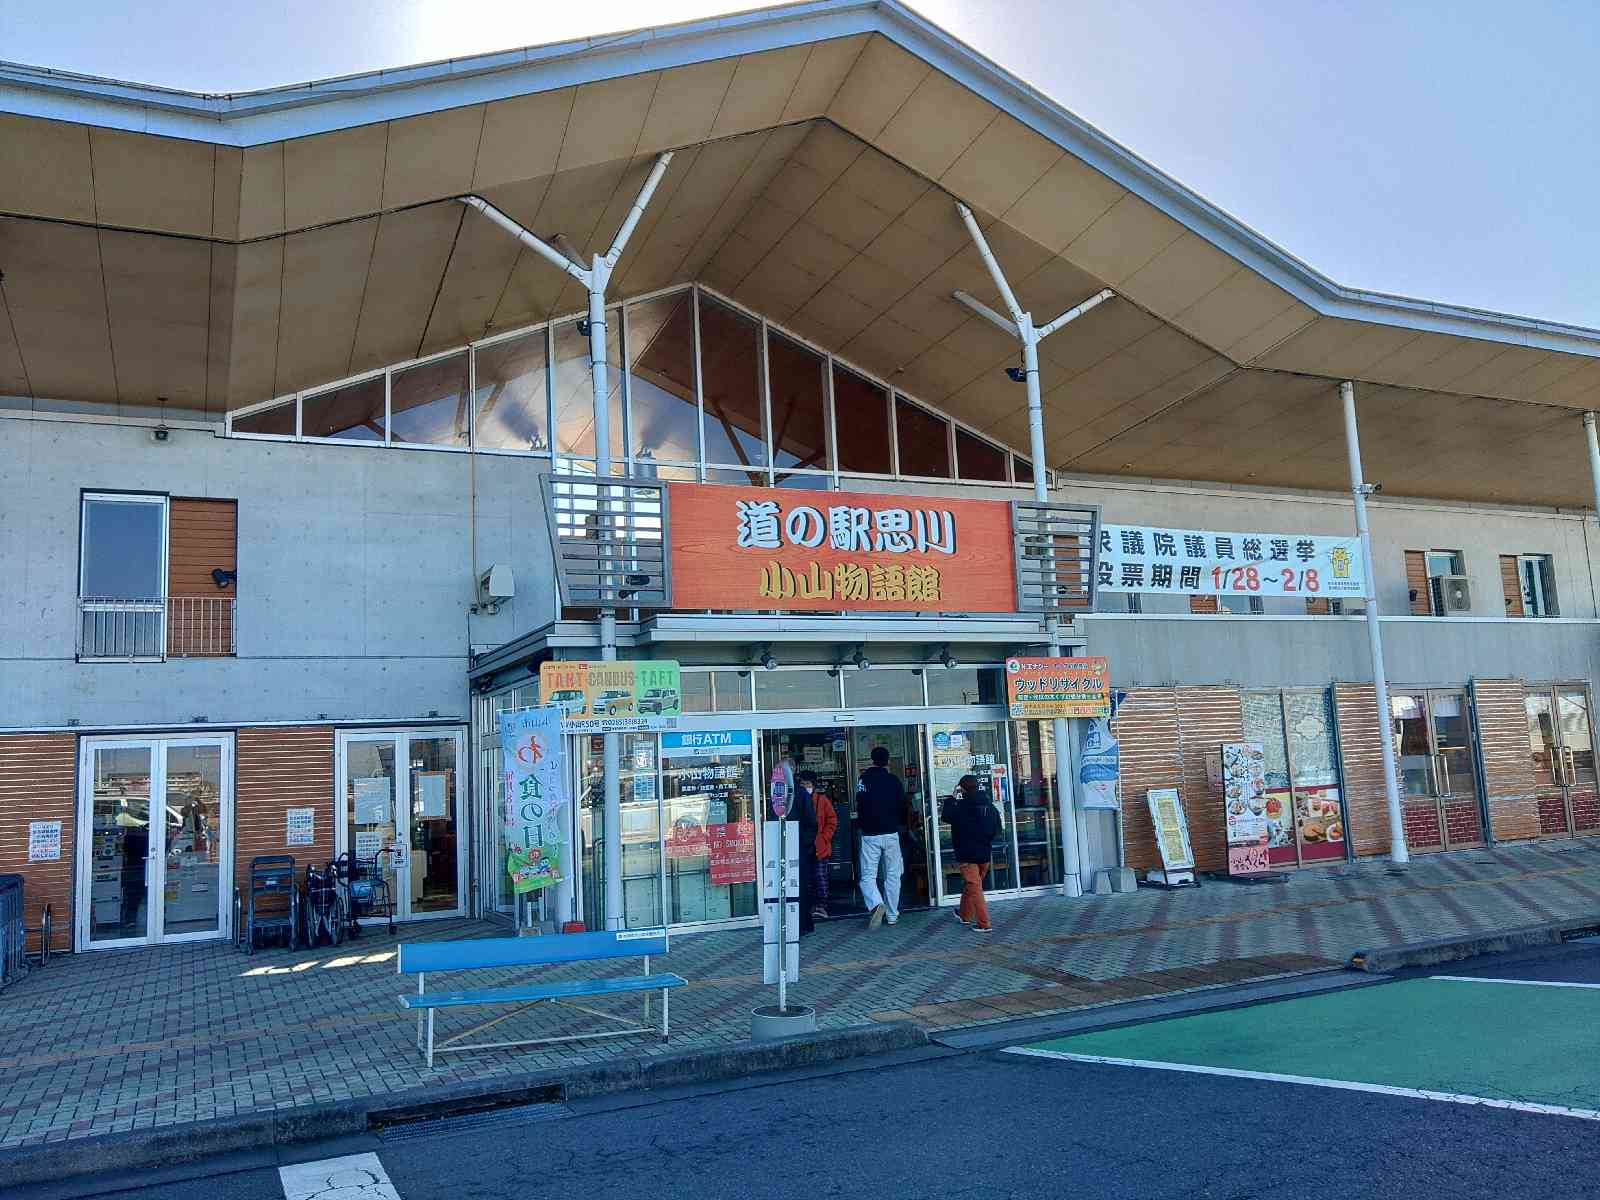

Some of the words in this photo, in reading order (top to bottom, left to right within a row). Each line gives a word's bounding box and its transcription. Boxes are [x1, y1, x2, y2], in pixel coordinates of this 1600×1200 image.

[735, 500, 957, 554] 道の駅思川
[759, 560, 942, 601] 小山物語館
[640, 670, 673, 687] TAFT
[1015, 677, 1104, 693] ウッドリサイクル
[681, 732, 732, 746] 銀行ATM
